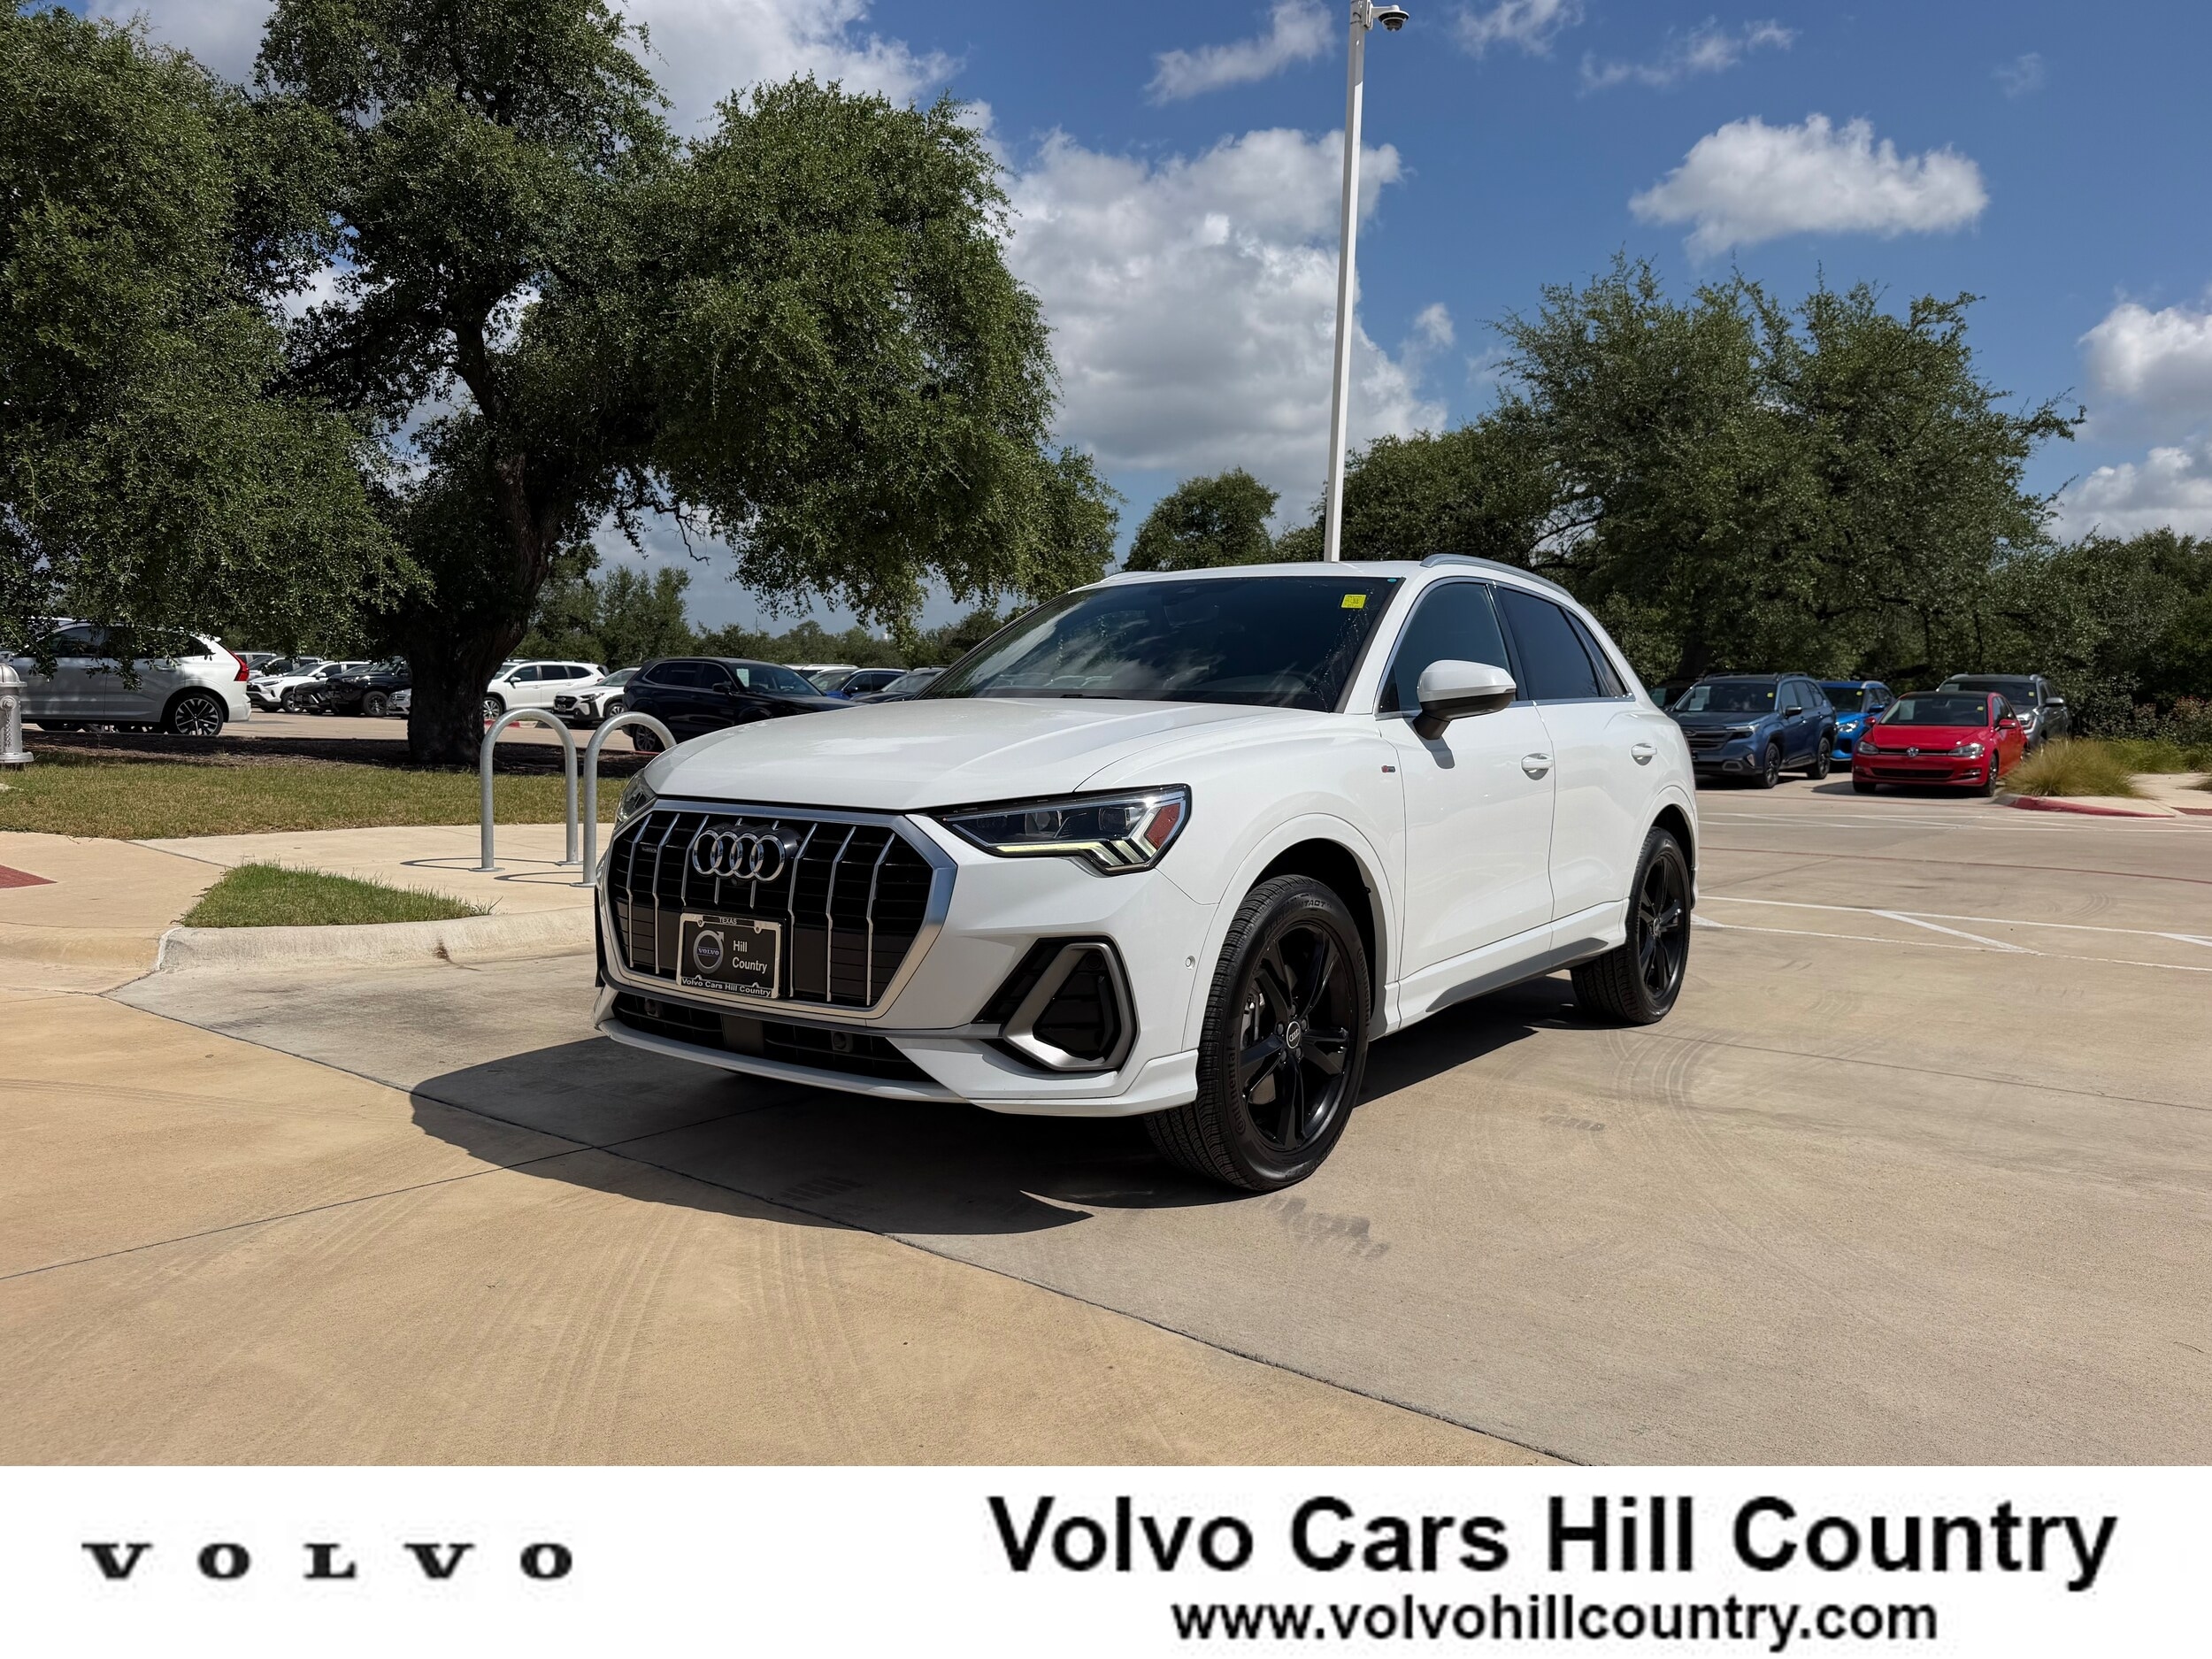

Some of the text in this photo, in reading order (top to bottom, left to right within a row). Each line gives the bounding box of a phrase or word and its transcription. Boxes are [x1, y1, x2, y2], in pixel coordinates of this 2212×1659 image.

[718, 917, 737, 926] TEXAS
[733, 940, 748, 953] Hill
[732, 956, 768, 974] Country
[681, 977, 772, 997] Volvo Cars Hill Country
